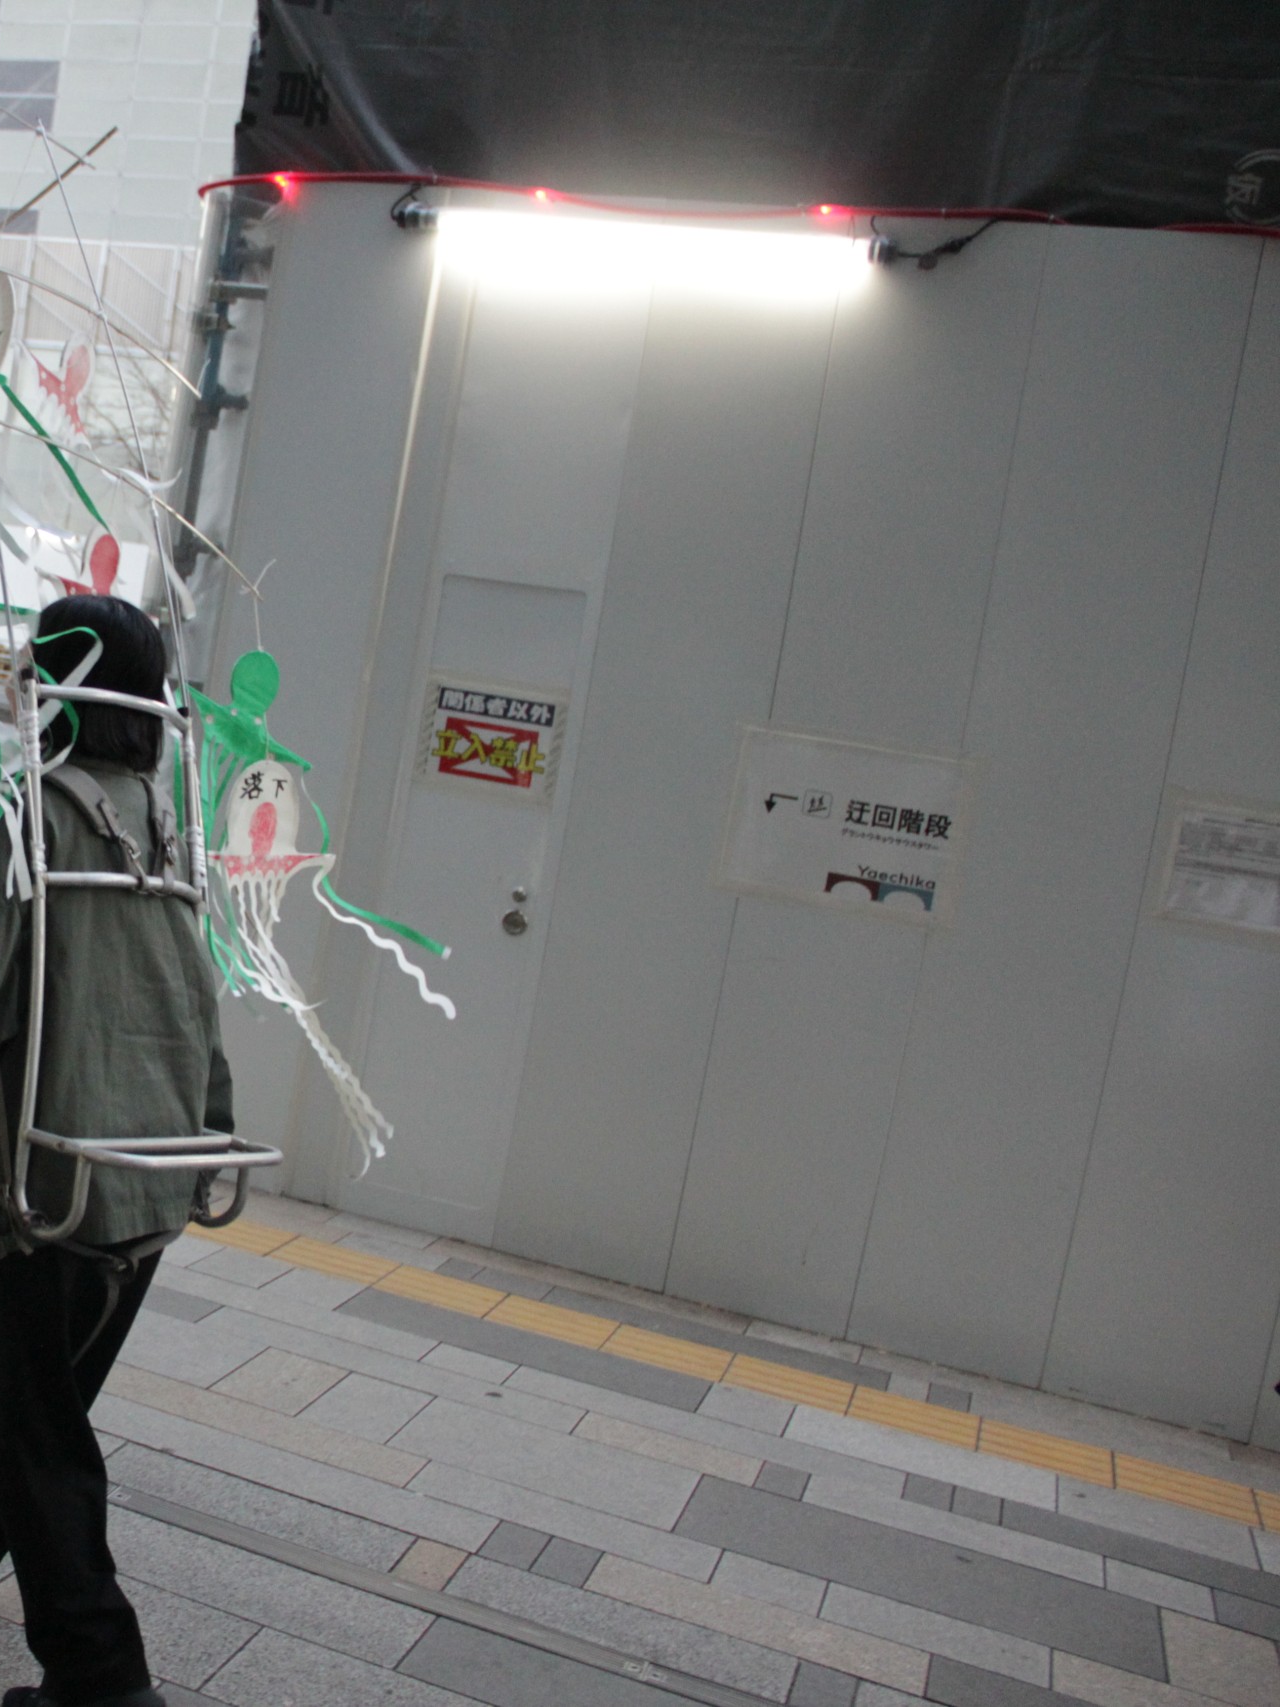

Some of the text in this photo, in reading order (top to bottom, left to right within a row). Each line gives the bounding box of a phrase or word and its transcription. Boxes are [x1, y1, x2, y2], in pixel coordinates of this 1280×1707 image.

[441, 689, 552, 724] 関係者以外
[432, 729, 546, 775] 立入禁止
[239, 770, 289, 800] 落下
[844, 799, 952, 840] 迂回階段
[857, 864, 937, 891] Yaechika
